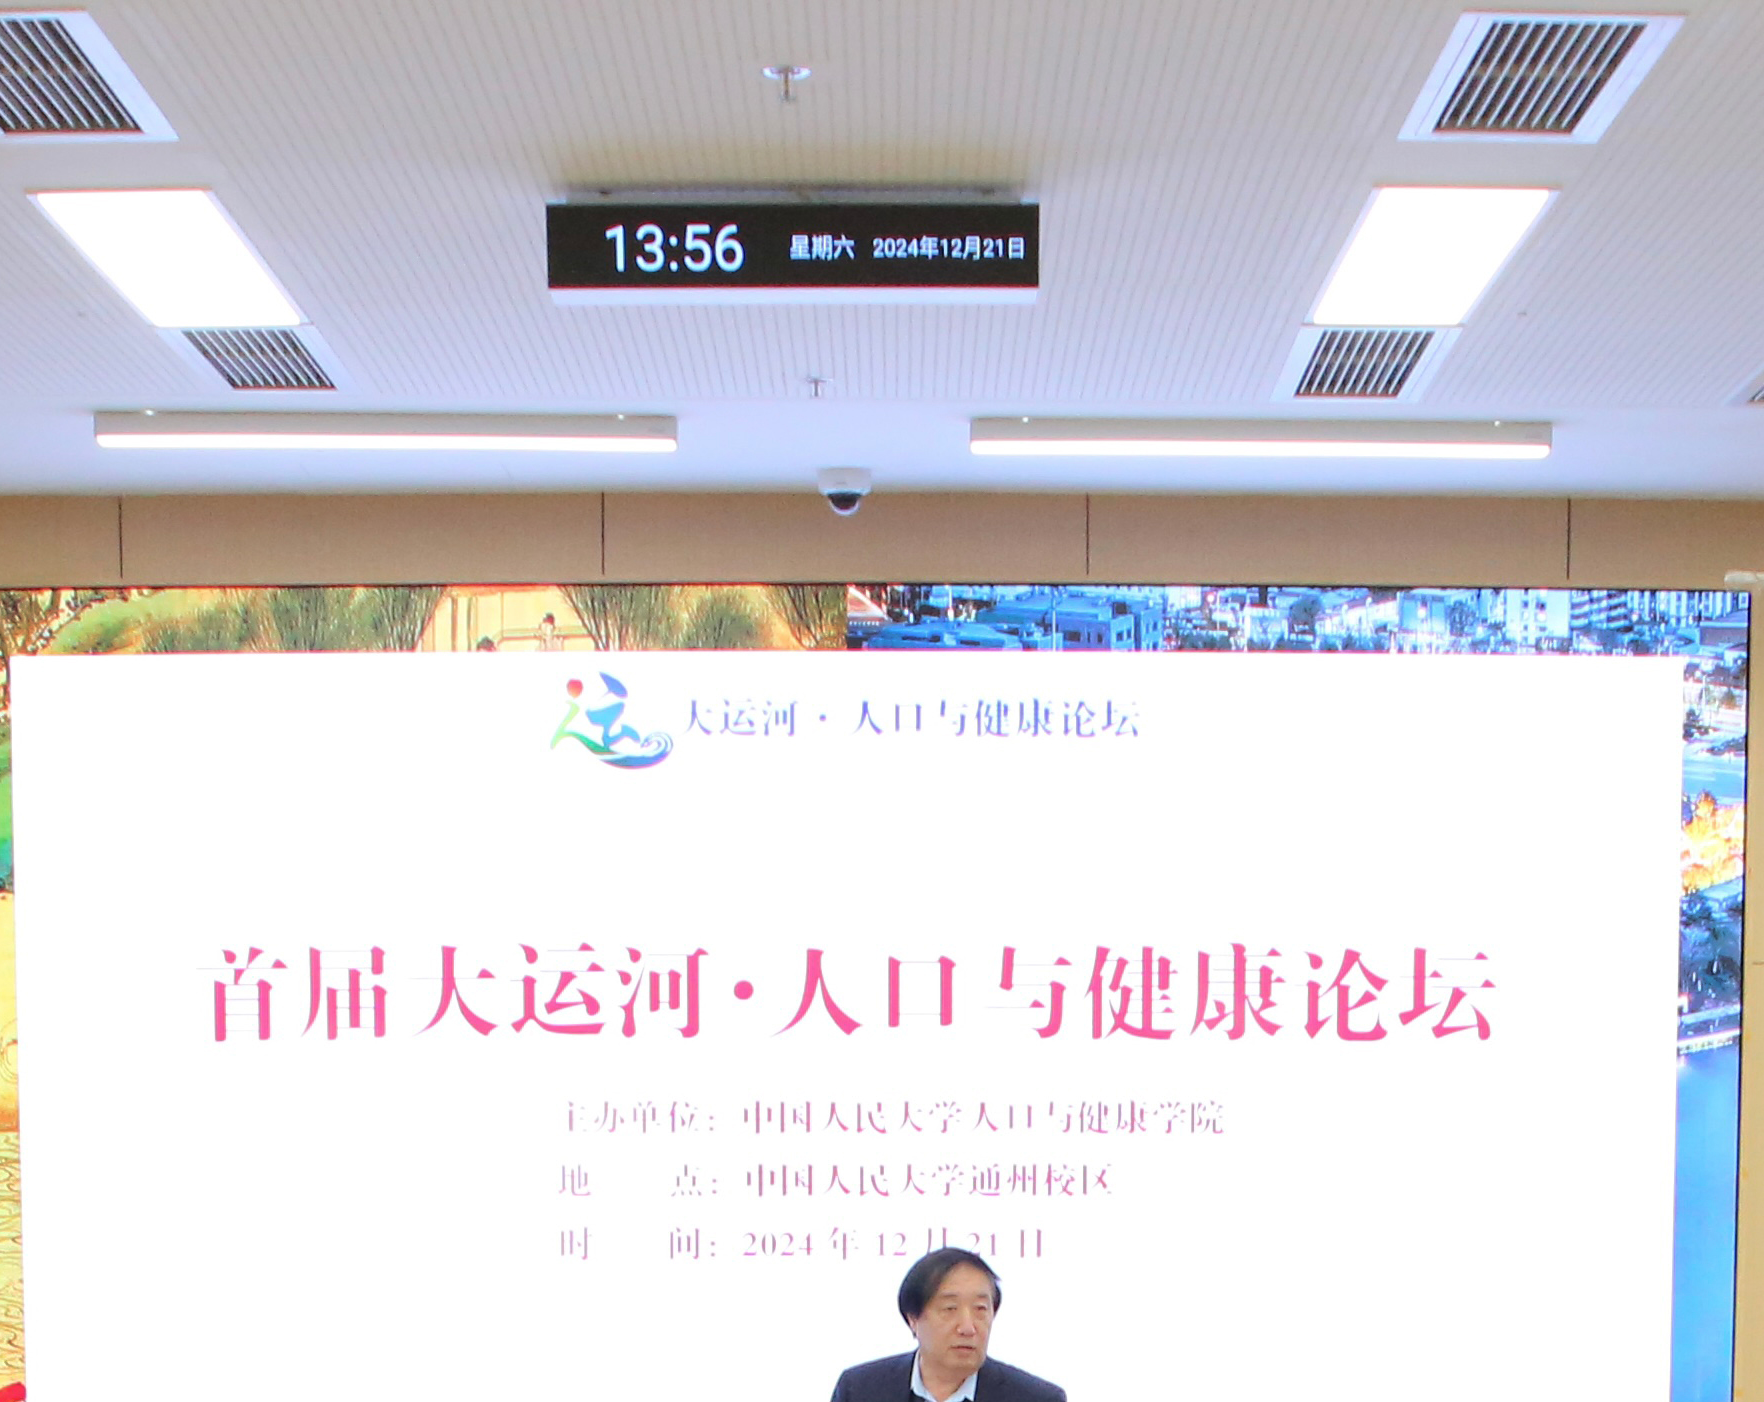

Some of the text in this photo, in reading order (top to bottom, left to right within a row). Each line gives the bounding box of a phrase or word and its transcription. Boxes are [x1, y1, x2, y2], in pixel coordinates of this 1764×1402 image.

[604, 224, 1026, 273] 13:56 星期六 2024年12月21日
[204, 943, 1496, 1044] 首届大运河·人口与健康论坛
